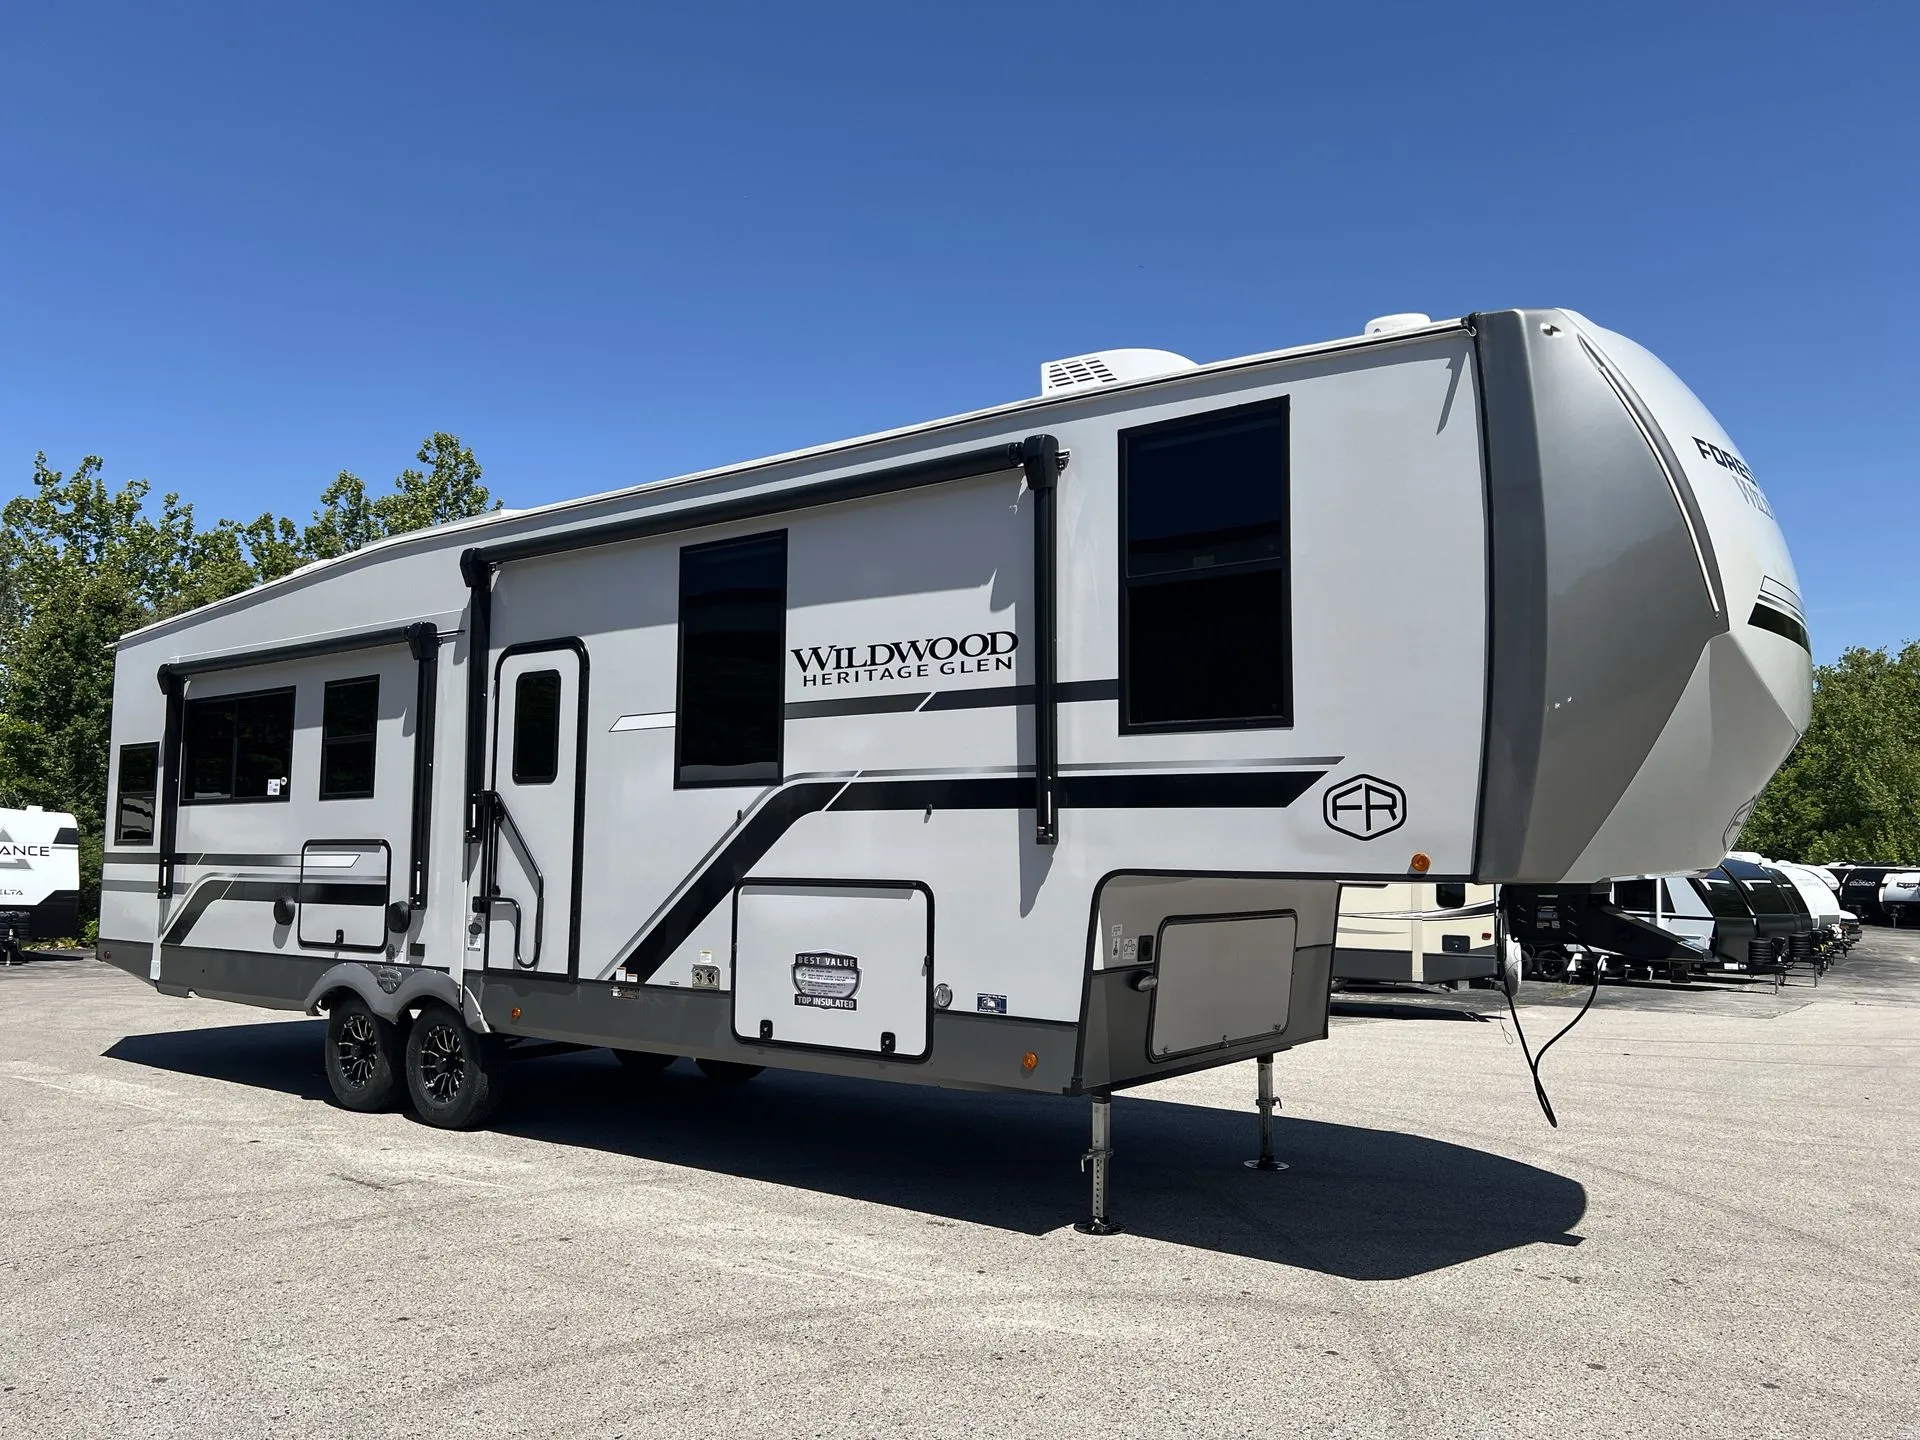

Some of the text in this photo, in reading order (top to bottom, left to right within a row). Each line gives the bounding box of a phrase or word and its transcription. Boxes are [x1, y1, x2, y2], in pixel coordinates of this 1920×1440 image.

[790, 631, 1019, 673] WILDWOOD
[803, 656, 1012, 687] HERITAGE GLEN
[797, 955, 855, 967] BEST VALUE
[797, 995, 855, 1009] TOP INSULATED
